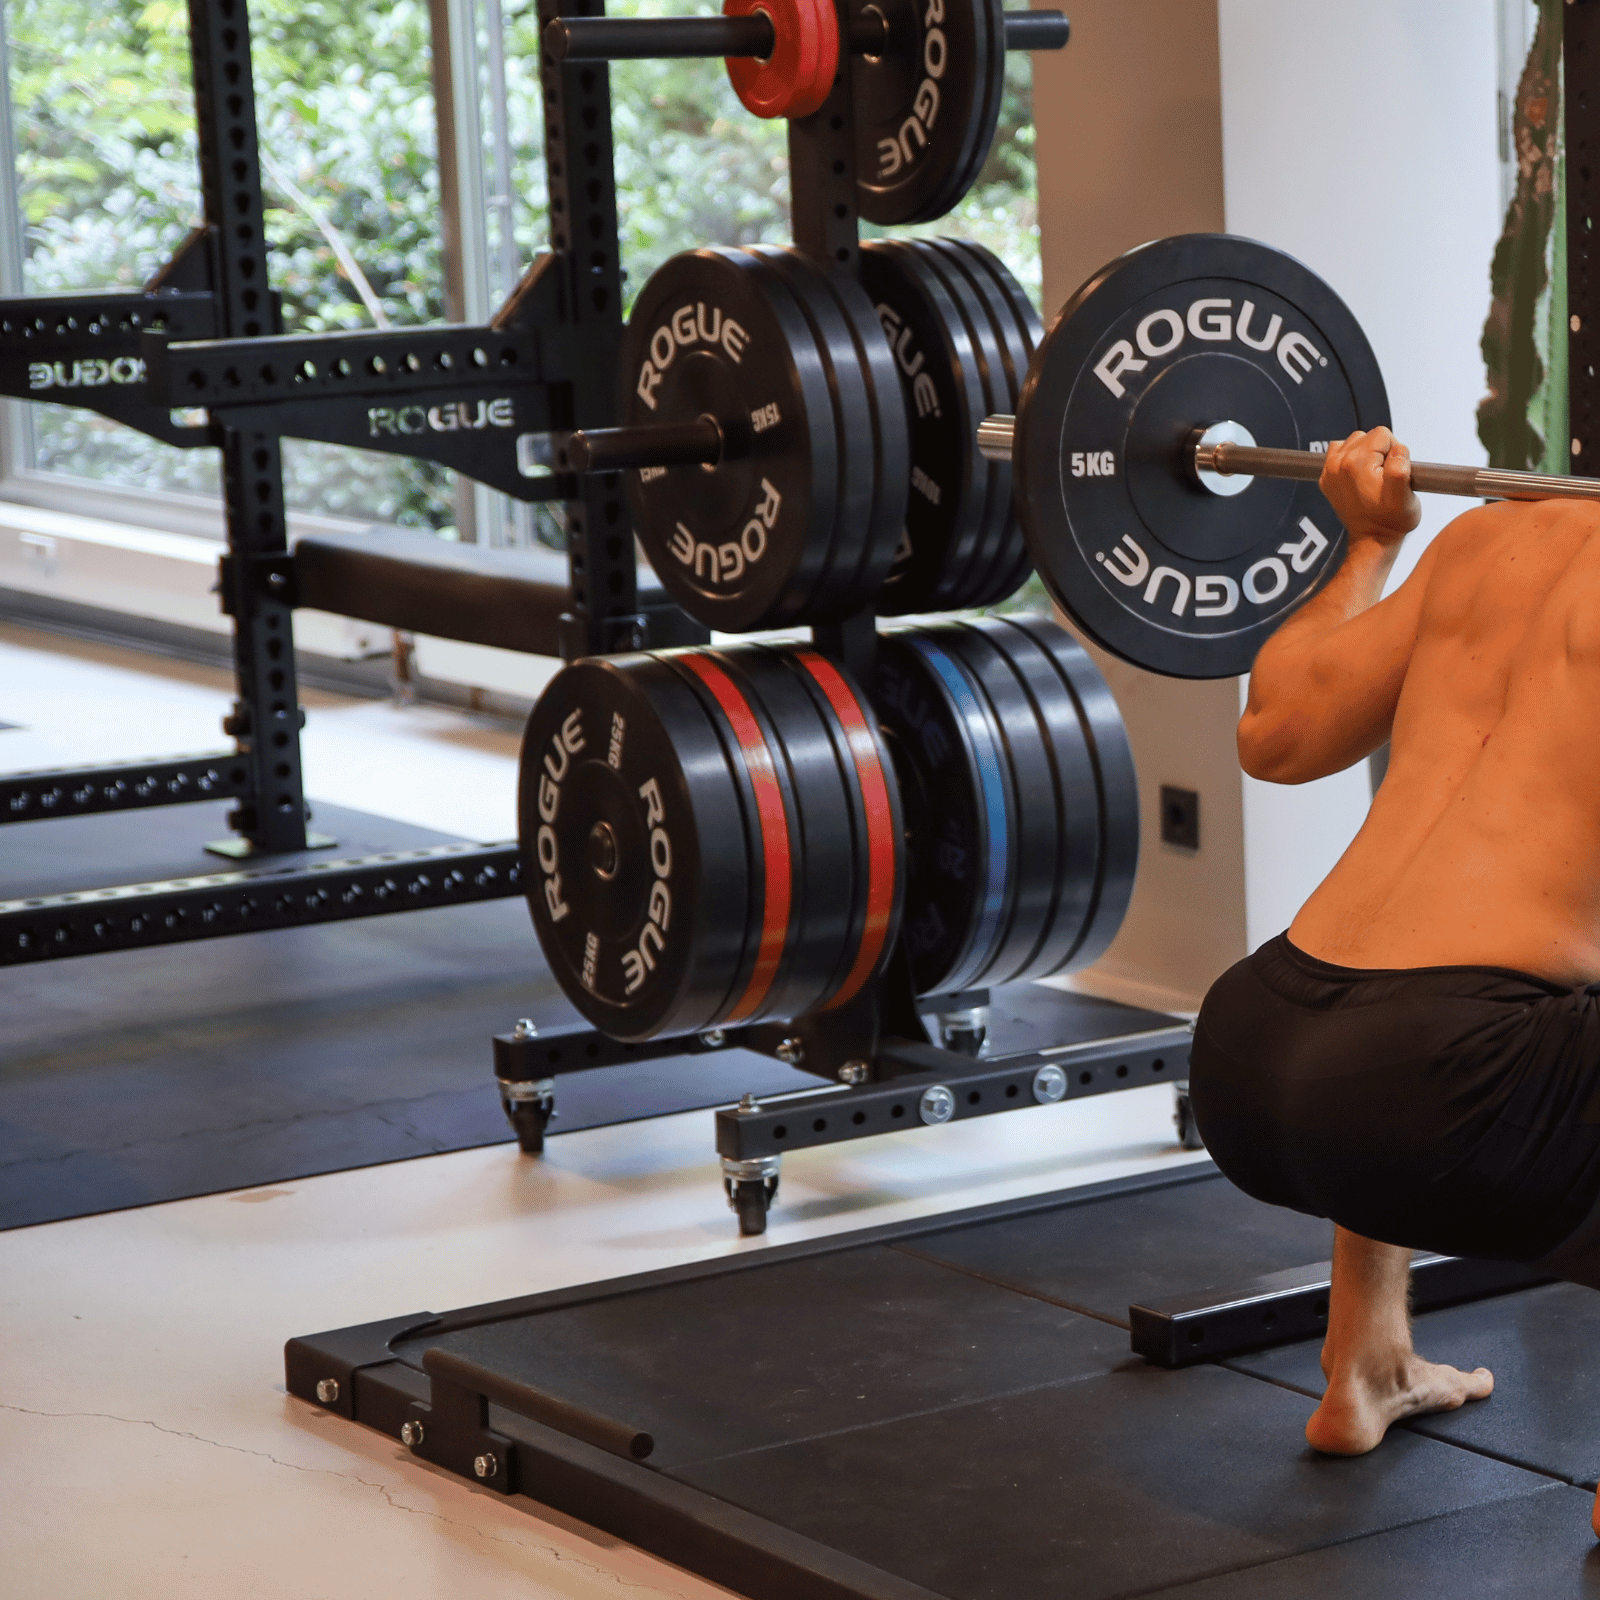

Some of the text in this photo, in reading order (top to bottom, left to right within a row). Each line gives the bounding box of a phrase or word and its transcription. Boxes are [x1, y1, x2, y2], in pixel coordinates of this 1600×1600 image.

[637, 302, 746, 409] ROGUE
[876, 302, 938, 419] GUE
[1093, 298, 1322, 399] ROGUE
[368, 398, 515, 437] ROGUE
[1071, 451, 1115, 477] 5KG
[669, 477, 782, 583] ROGUE
[1103, 516, 1329, 617] ROGUE
[607, 711, 626, 770] 25KG
[538, 709, 587, 922] ROGUE
[621, 776, 673, 995] ROGUE
